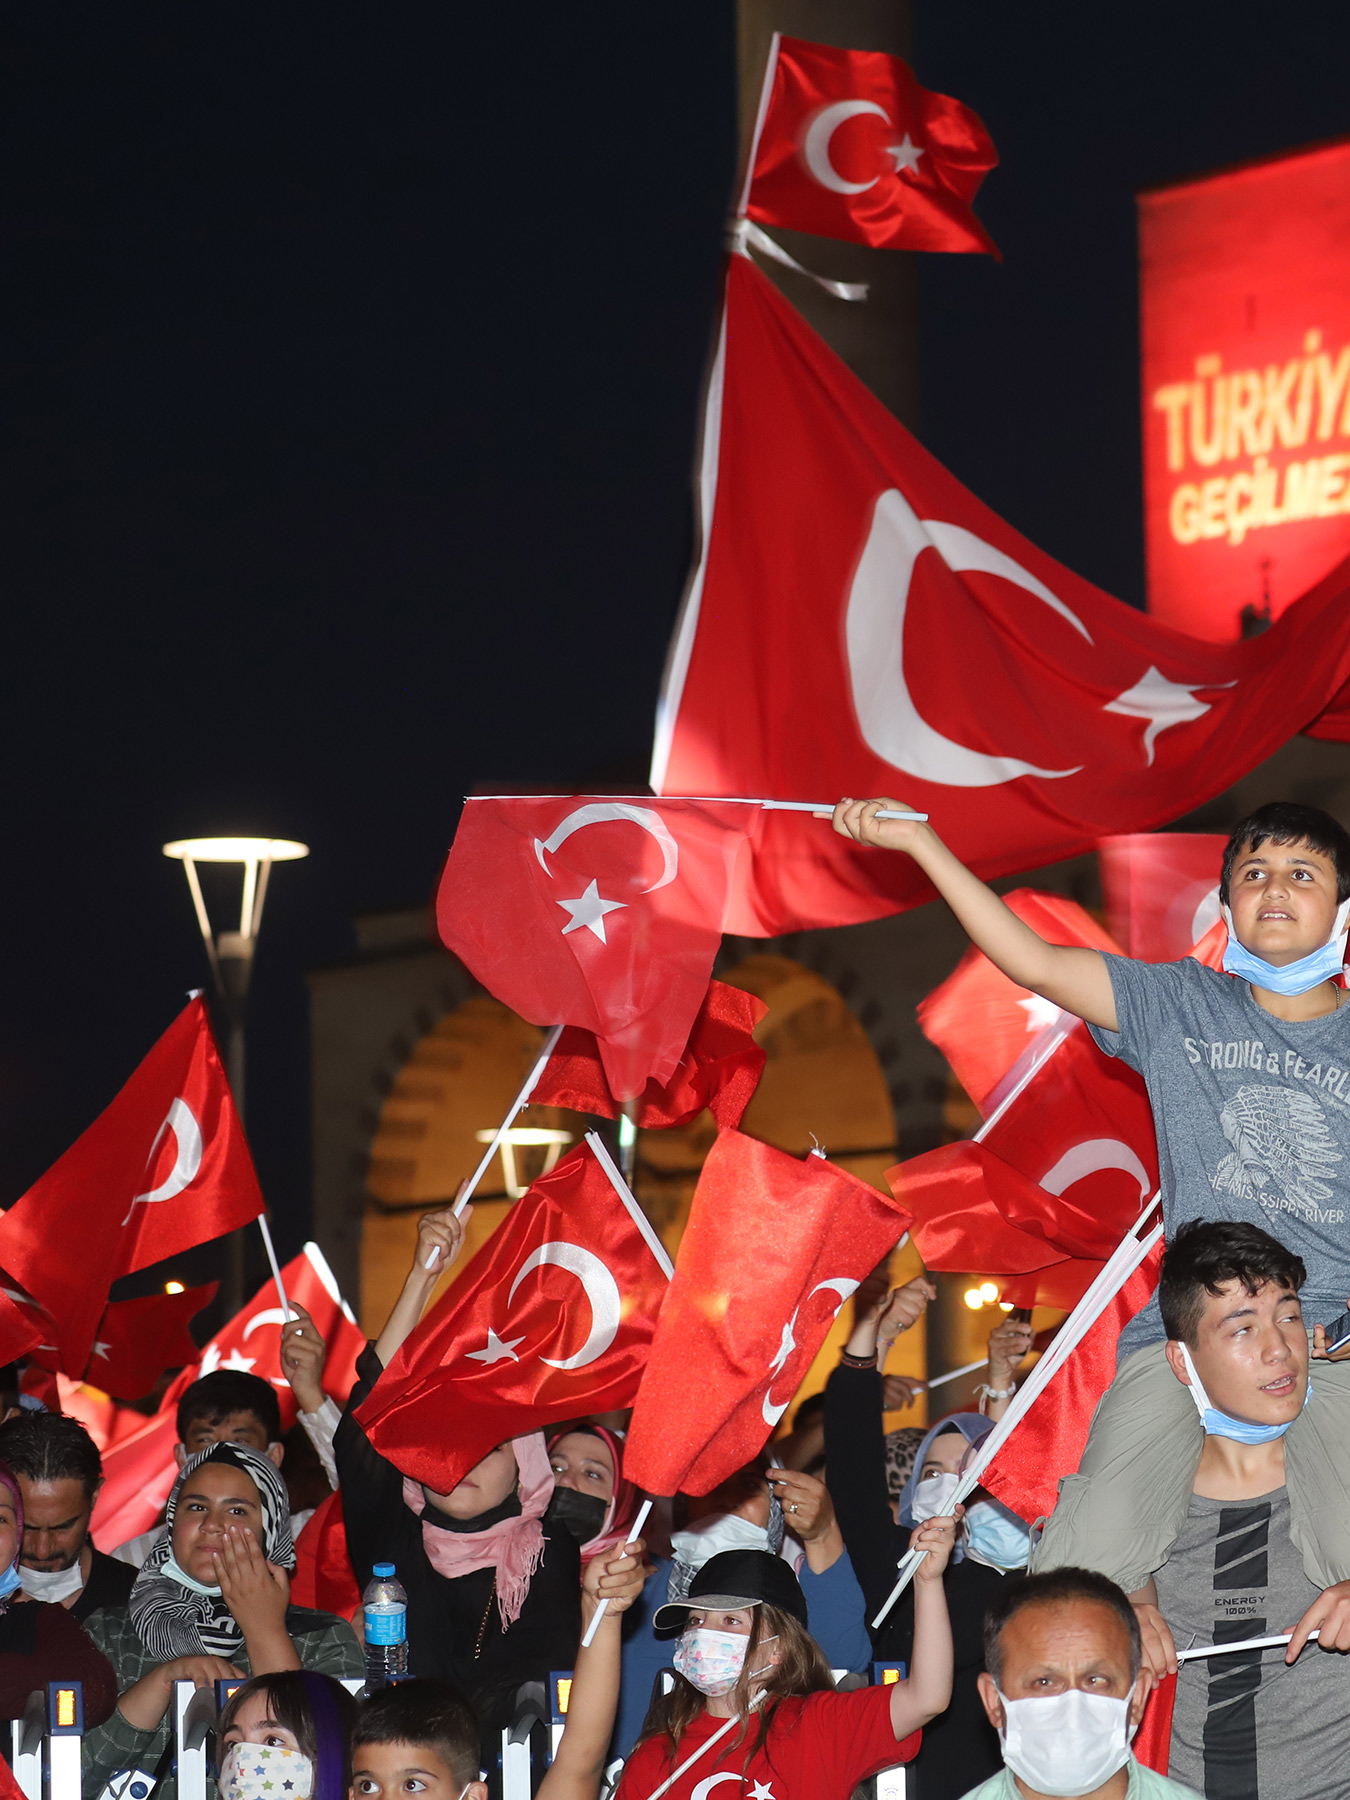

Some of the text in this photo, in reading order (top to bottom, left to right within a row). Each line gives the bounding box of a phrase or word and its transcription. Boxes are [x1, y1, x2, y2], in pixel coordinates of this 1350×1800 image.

[1184, 1037, 1264, 1070] STRONG
[1266, 1052, 1281, 1075] &
[1206, 1171, 1345, 1224] HE MISSSIPPI RIVER
[1214, 1595, 1266, 1606] ENERGY
[1225, 1606, 1257, 1615] 100%
